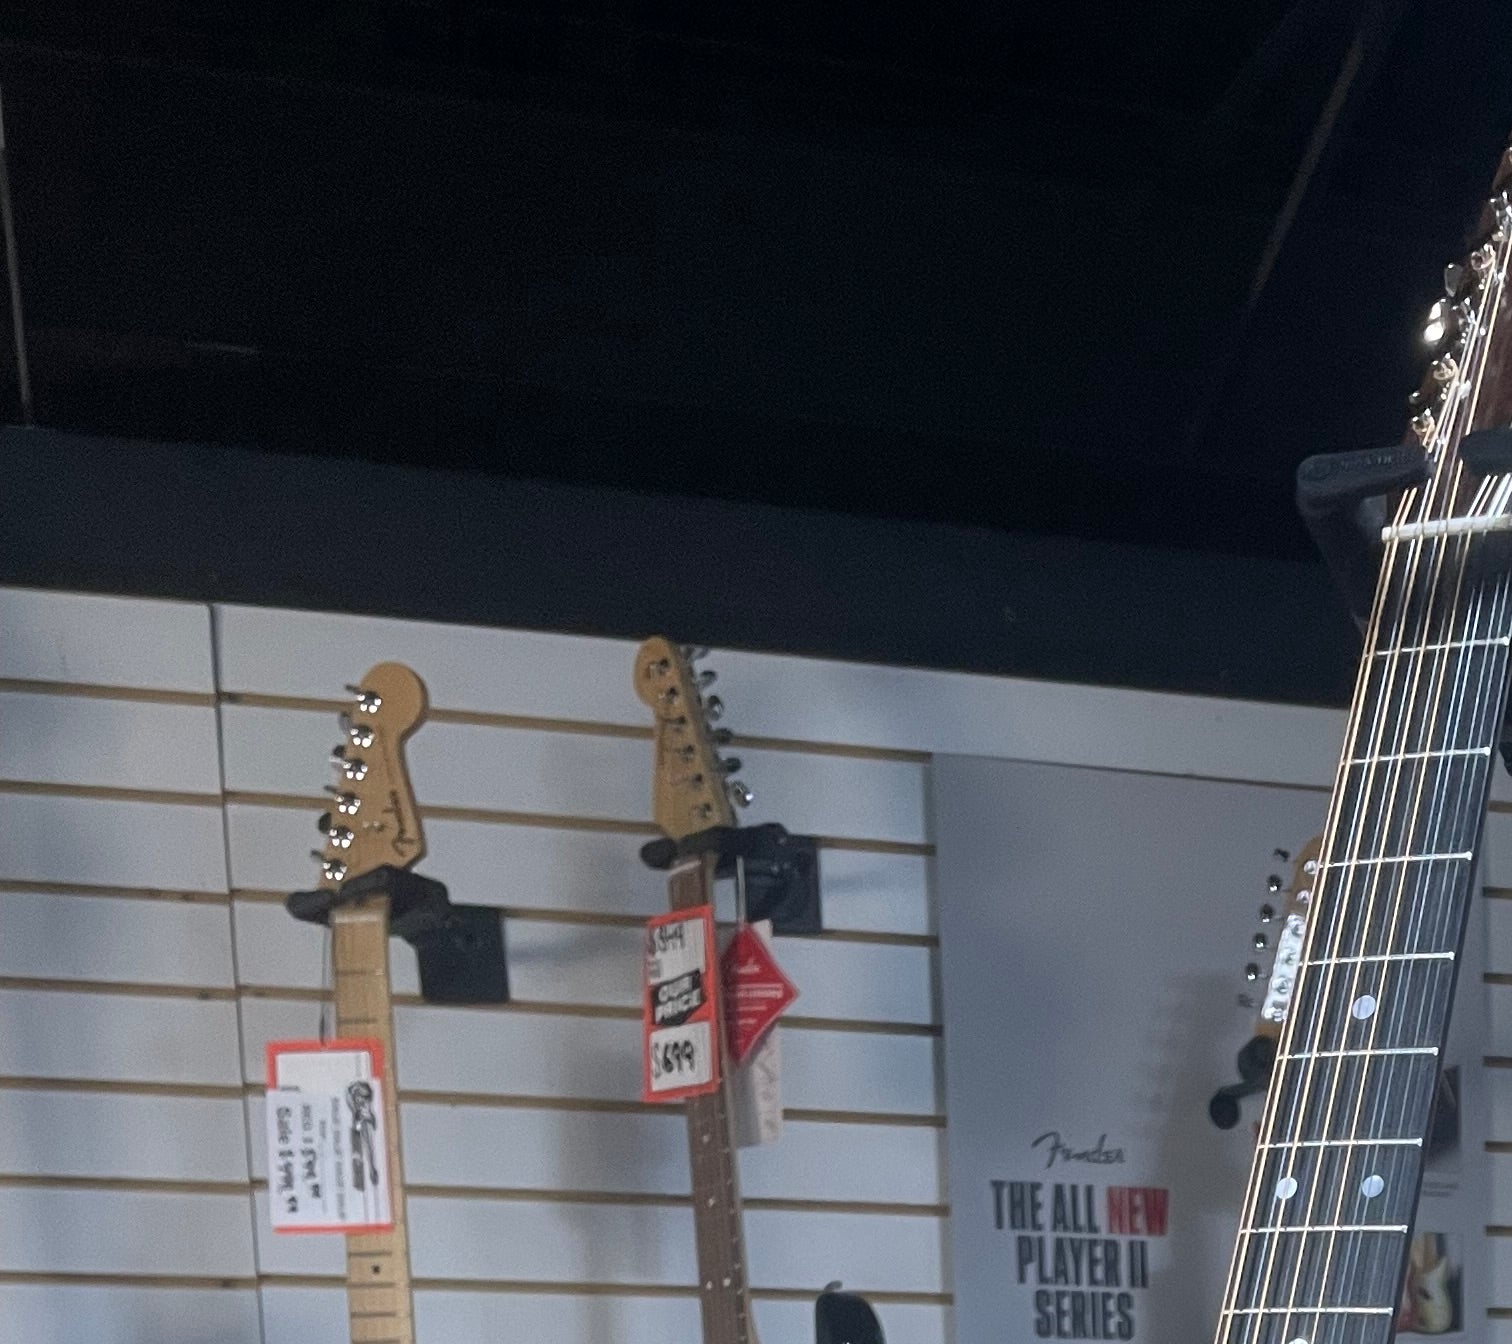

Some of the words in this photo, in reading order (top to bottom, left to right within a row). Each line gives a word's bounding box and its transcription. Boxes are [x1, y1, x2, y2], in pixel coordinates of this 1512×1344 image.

[1031, 1131, 1126, 1170] Fender
[991, 1180, 1043, 1230] THE
[1052, 1184, 1099, 1234] ALL
[1106, 1186, 1168, 1236] NEW
[1017, 1236, 1121, 1287] PLAYER
[1128, 1240, 1148, 1288] II
[1035, 1289, 1135, 1341] SERIES
